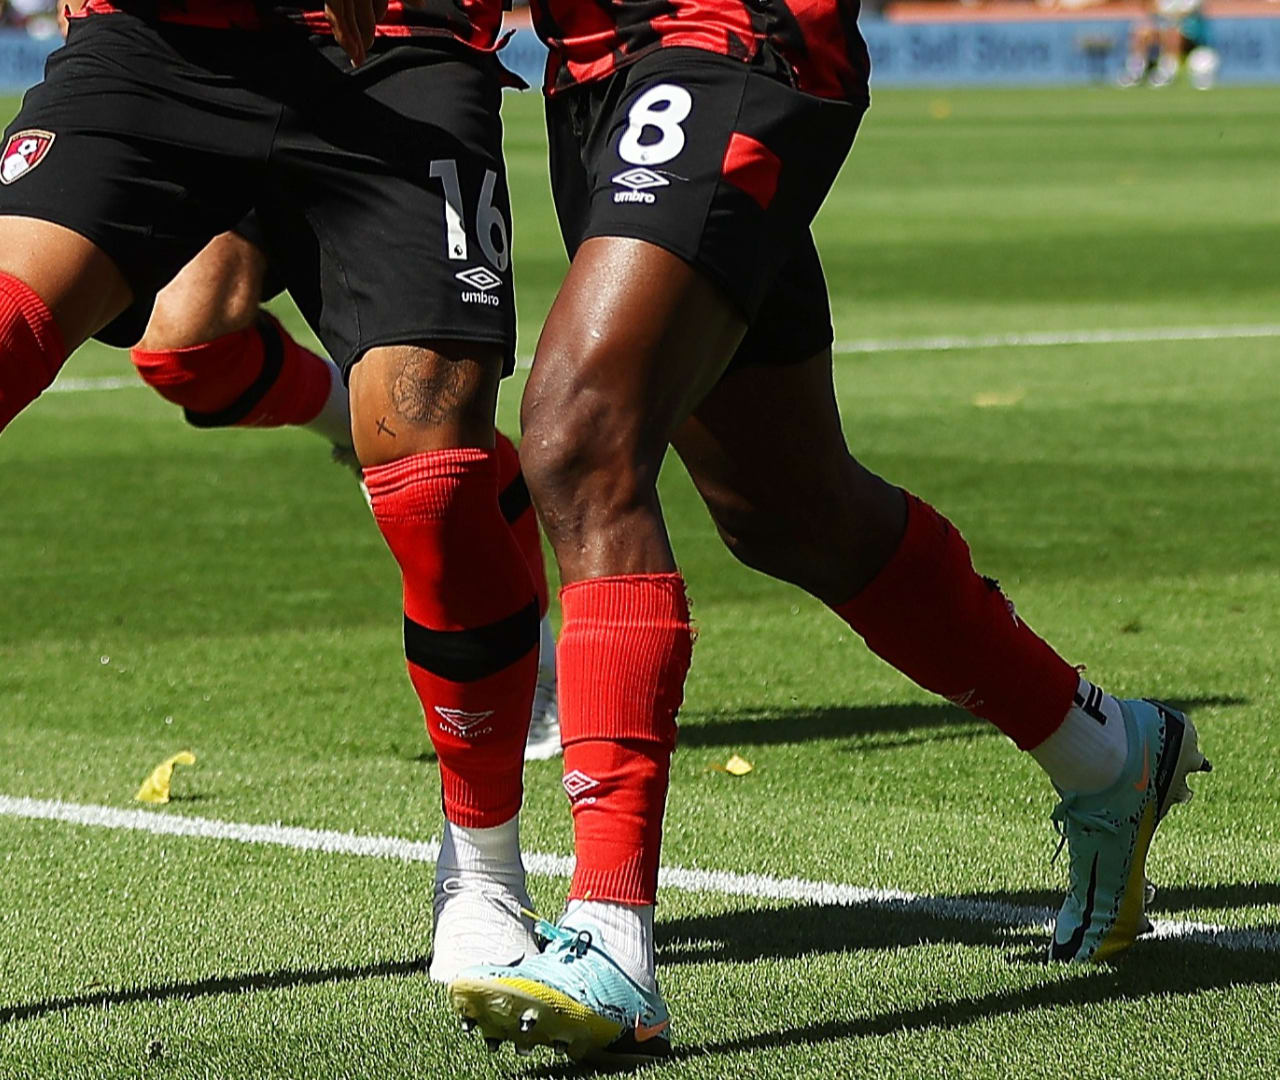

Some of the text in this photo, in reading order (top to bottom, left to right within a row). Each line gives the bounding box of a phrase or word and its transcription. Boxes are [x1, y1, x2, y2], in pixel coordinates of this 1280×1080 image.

[618, 83, 692, 166] 8
[429, 160, 508, 271] 16
[614, 190, 655, 204] umbro
[461, 290, 499, 307] umbro
